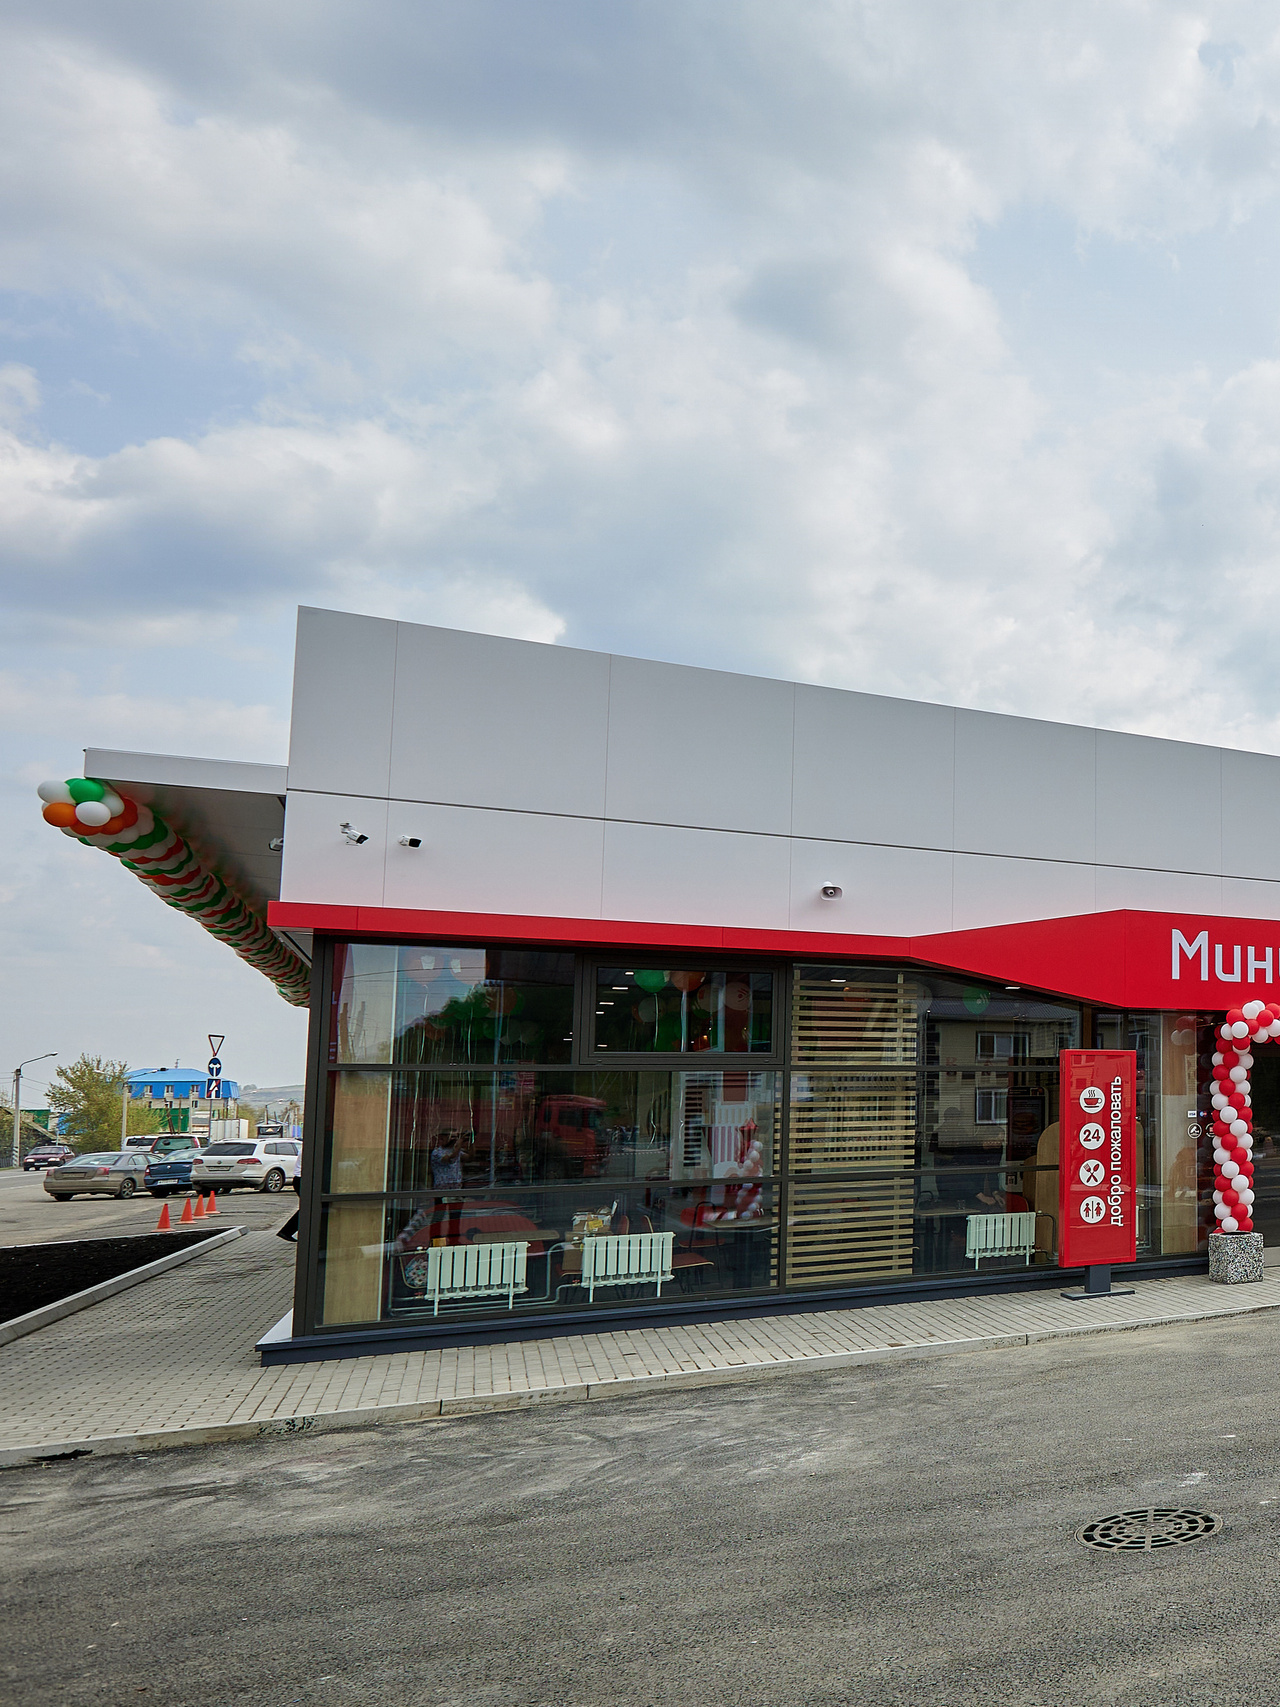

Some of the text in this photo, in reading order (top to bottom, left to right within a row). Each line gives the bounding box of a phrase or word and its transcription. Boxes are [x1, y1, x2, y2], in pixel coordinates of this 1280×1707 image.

[1083, 1129, 1101, 1142] 24
[1107, 1076, 1124, 1227] добро пожаловать
